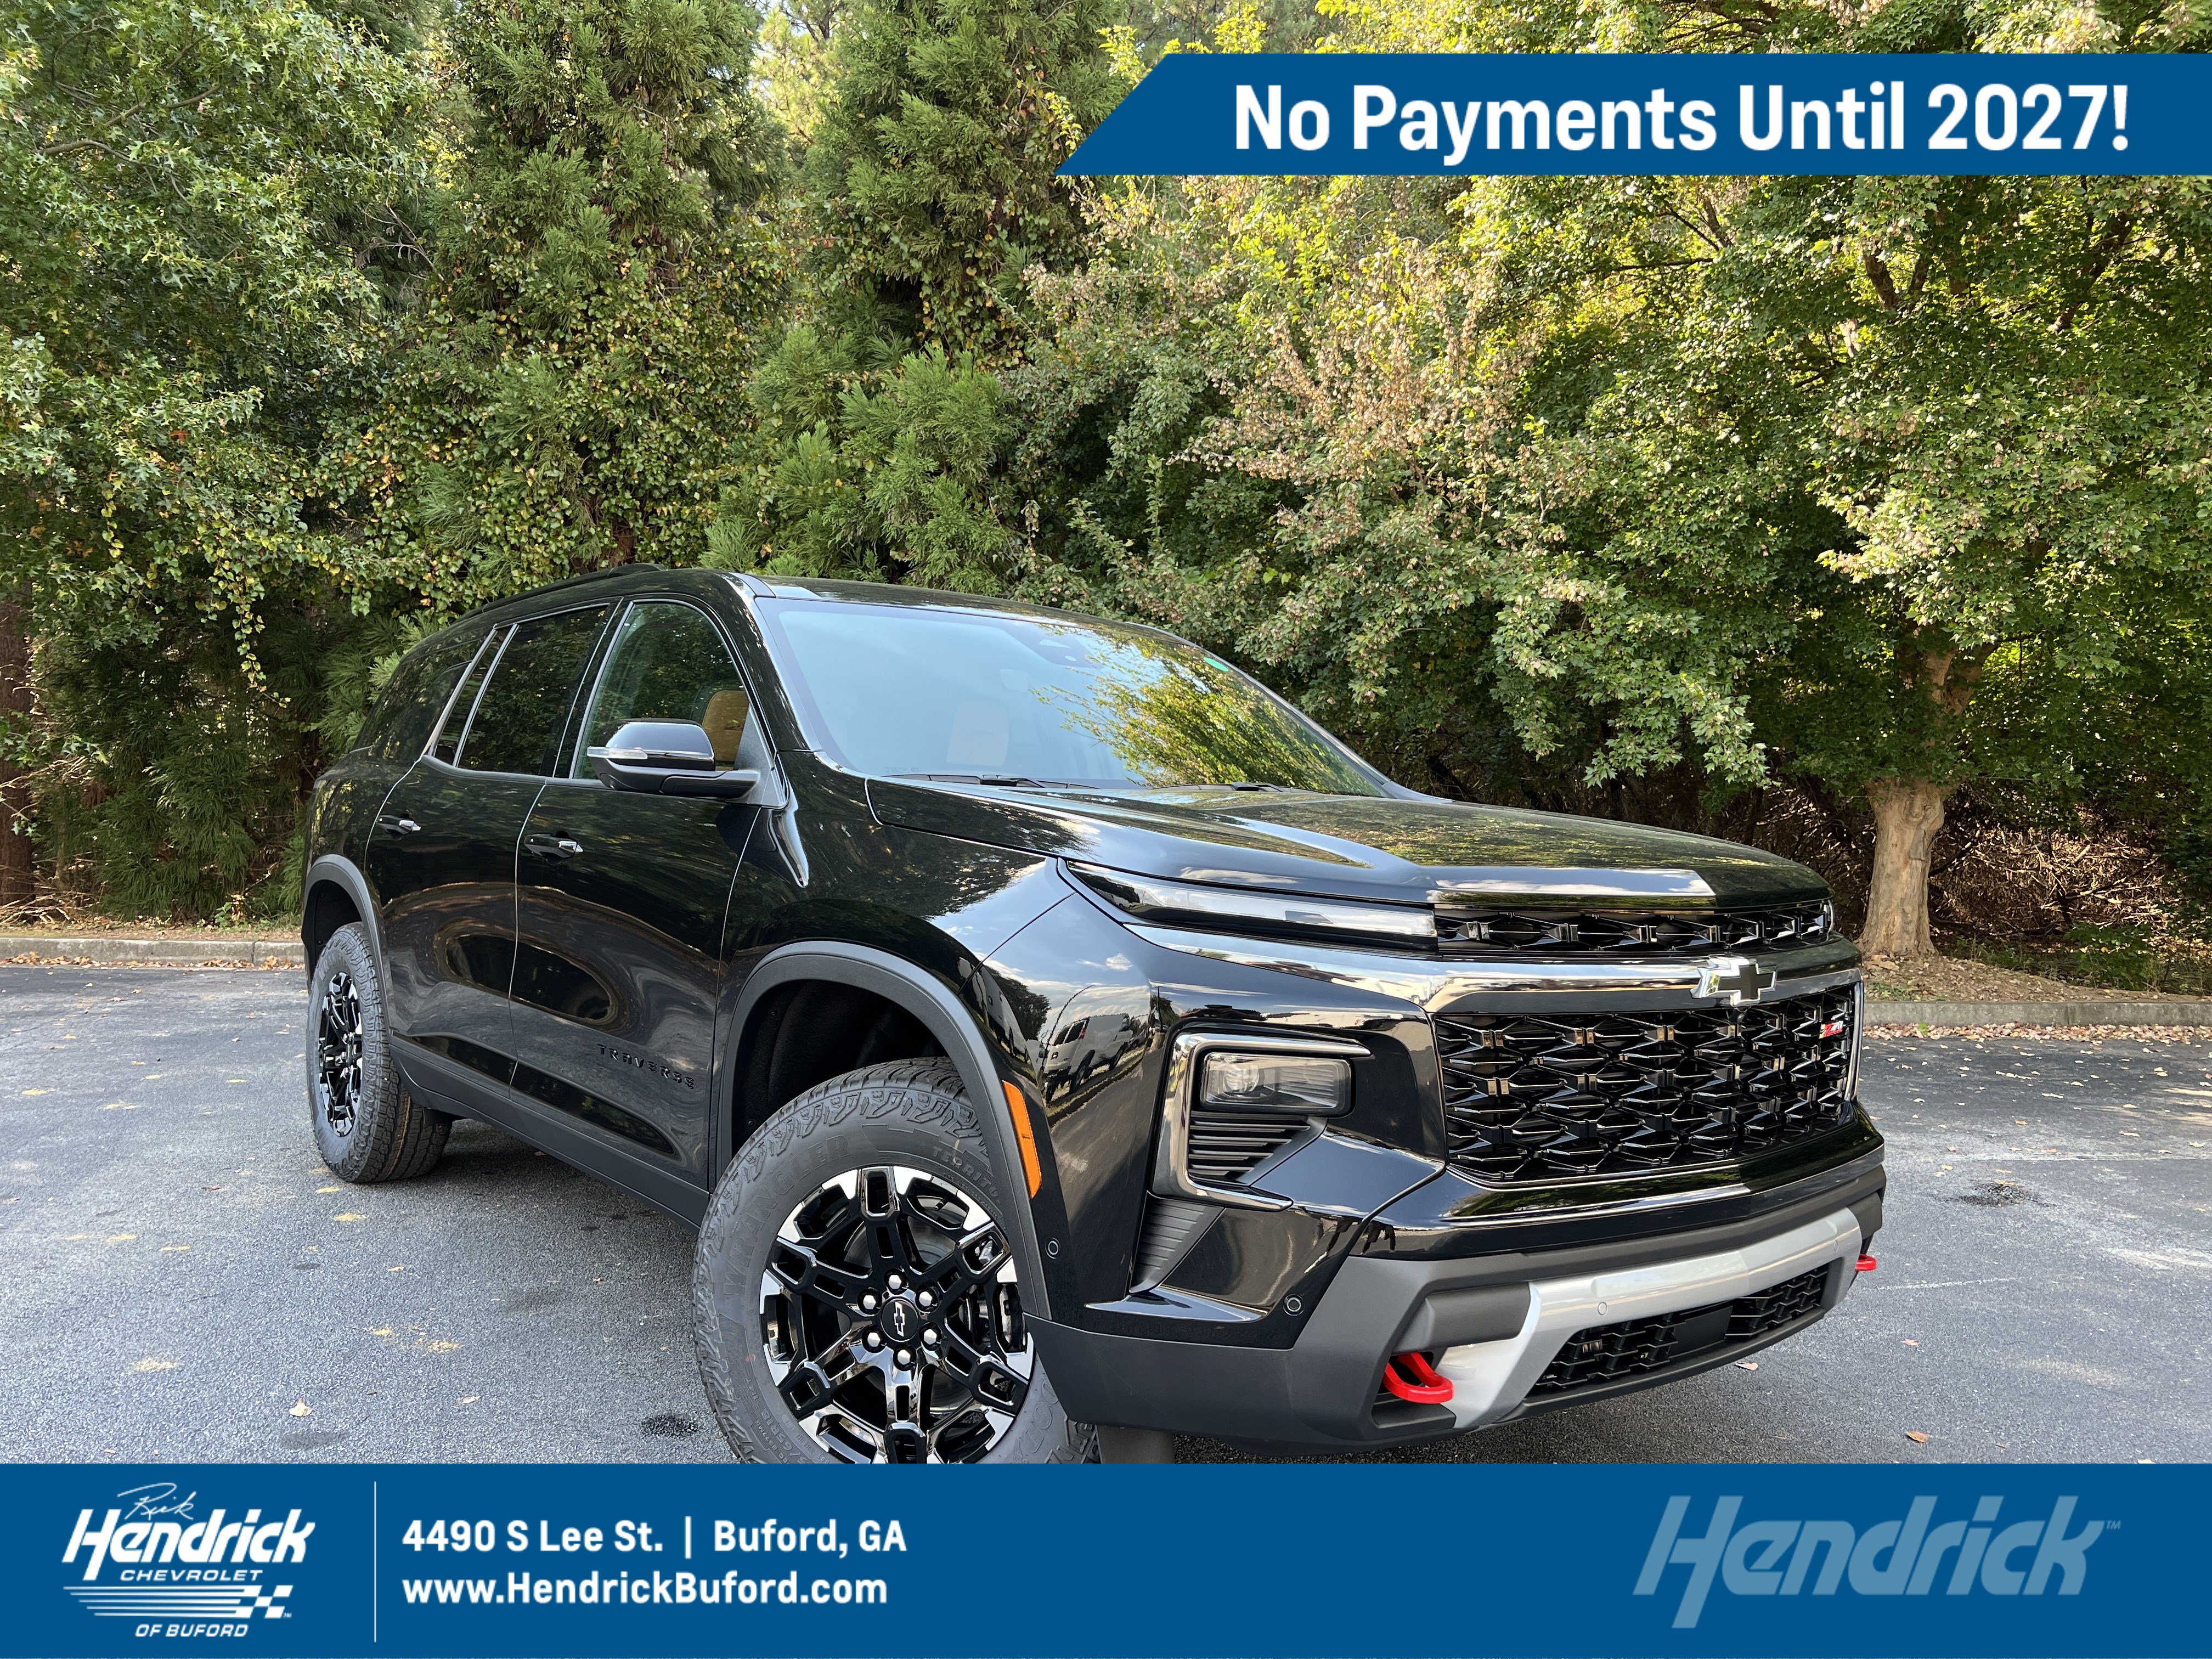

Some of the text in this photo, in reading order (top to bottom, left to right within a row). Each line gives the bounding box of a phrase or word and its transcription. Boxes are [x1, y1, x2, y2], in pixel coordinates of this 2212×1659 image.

[596, 1043, 695, 1090] TRAVERSE
[933, 1146, 1000, 1204] TERRITO
[723, 1134, 850, 1296] WRANGLER
